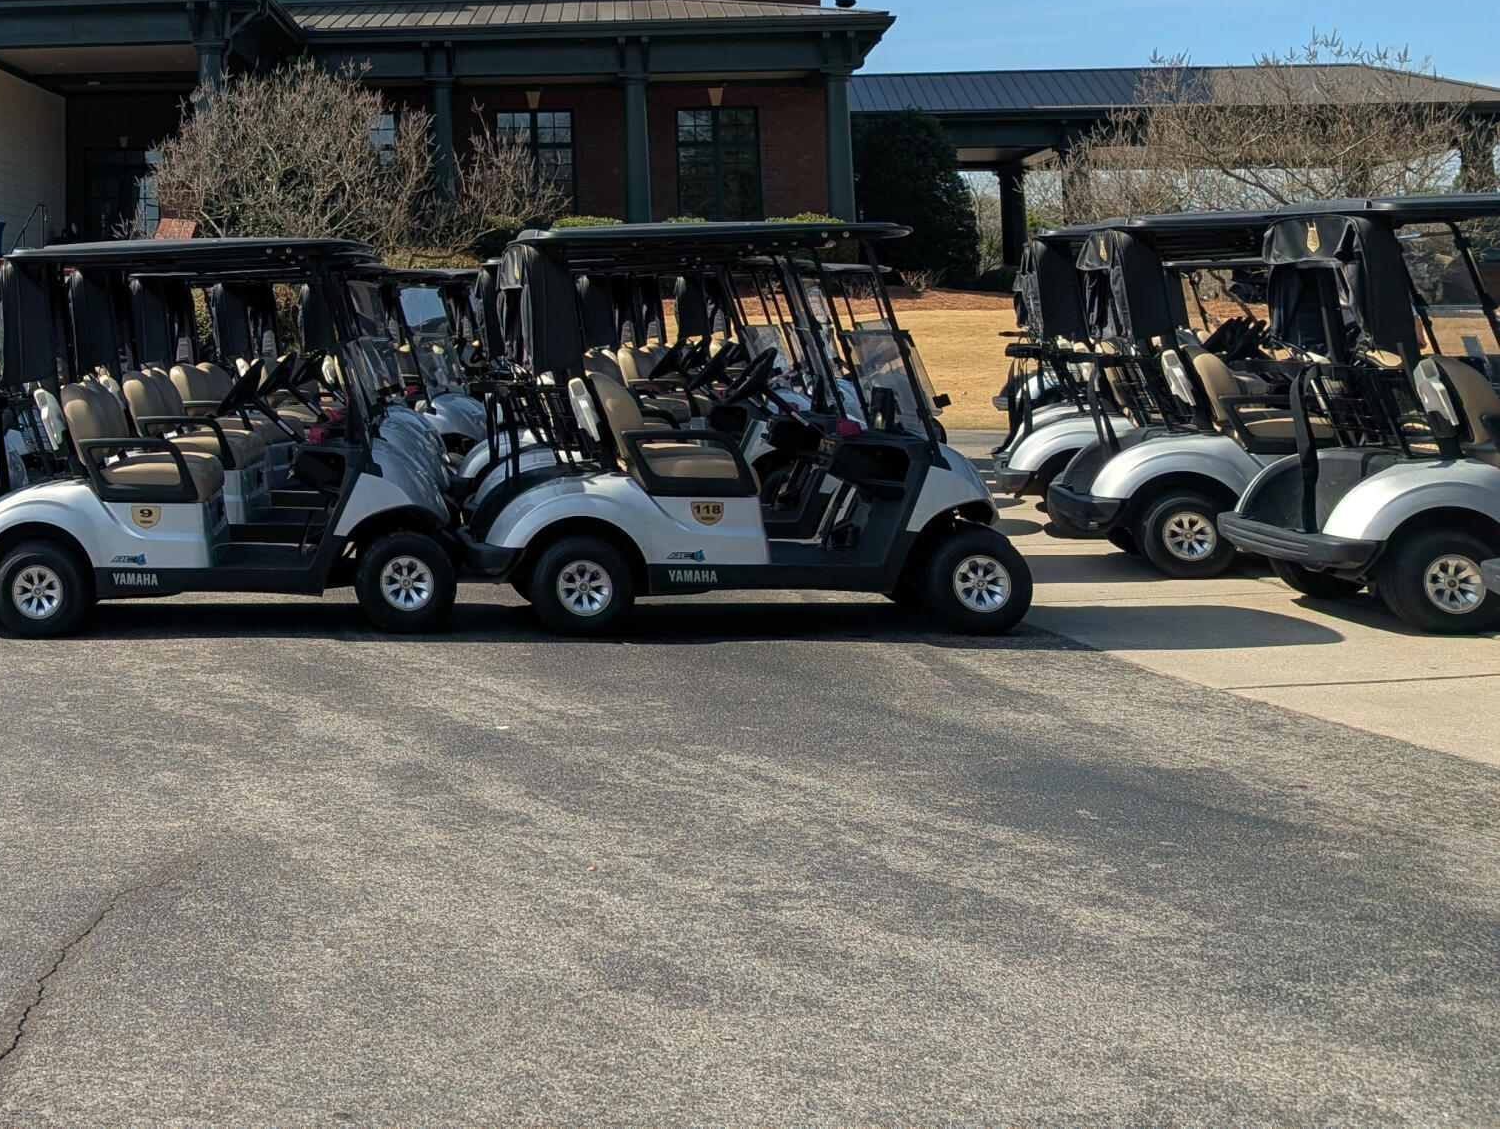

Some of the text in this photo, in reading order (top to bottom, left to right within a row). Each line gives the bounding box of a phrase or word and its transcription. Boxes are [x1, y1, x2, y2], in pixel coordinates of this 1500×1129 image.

[140, 509, 153, 517] 9
[694, 505, 721, 514] 118
[113, 573, 159, 585] YAMAHA
[668, 570, 718, 583] YAMAHA
